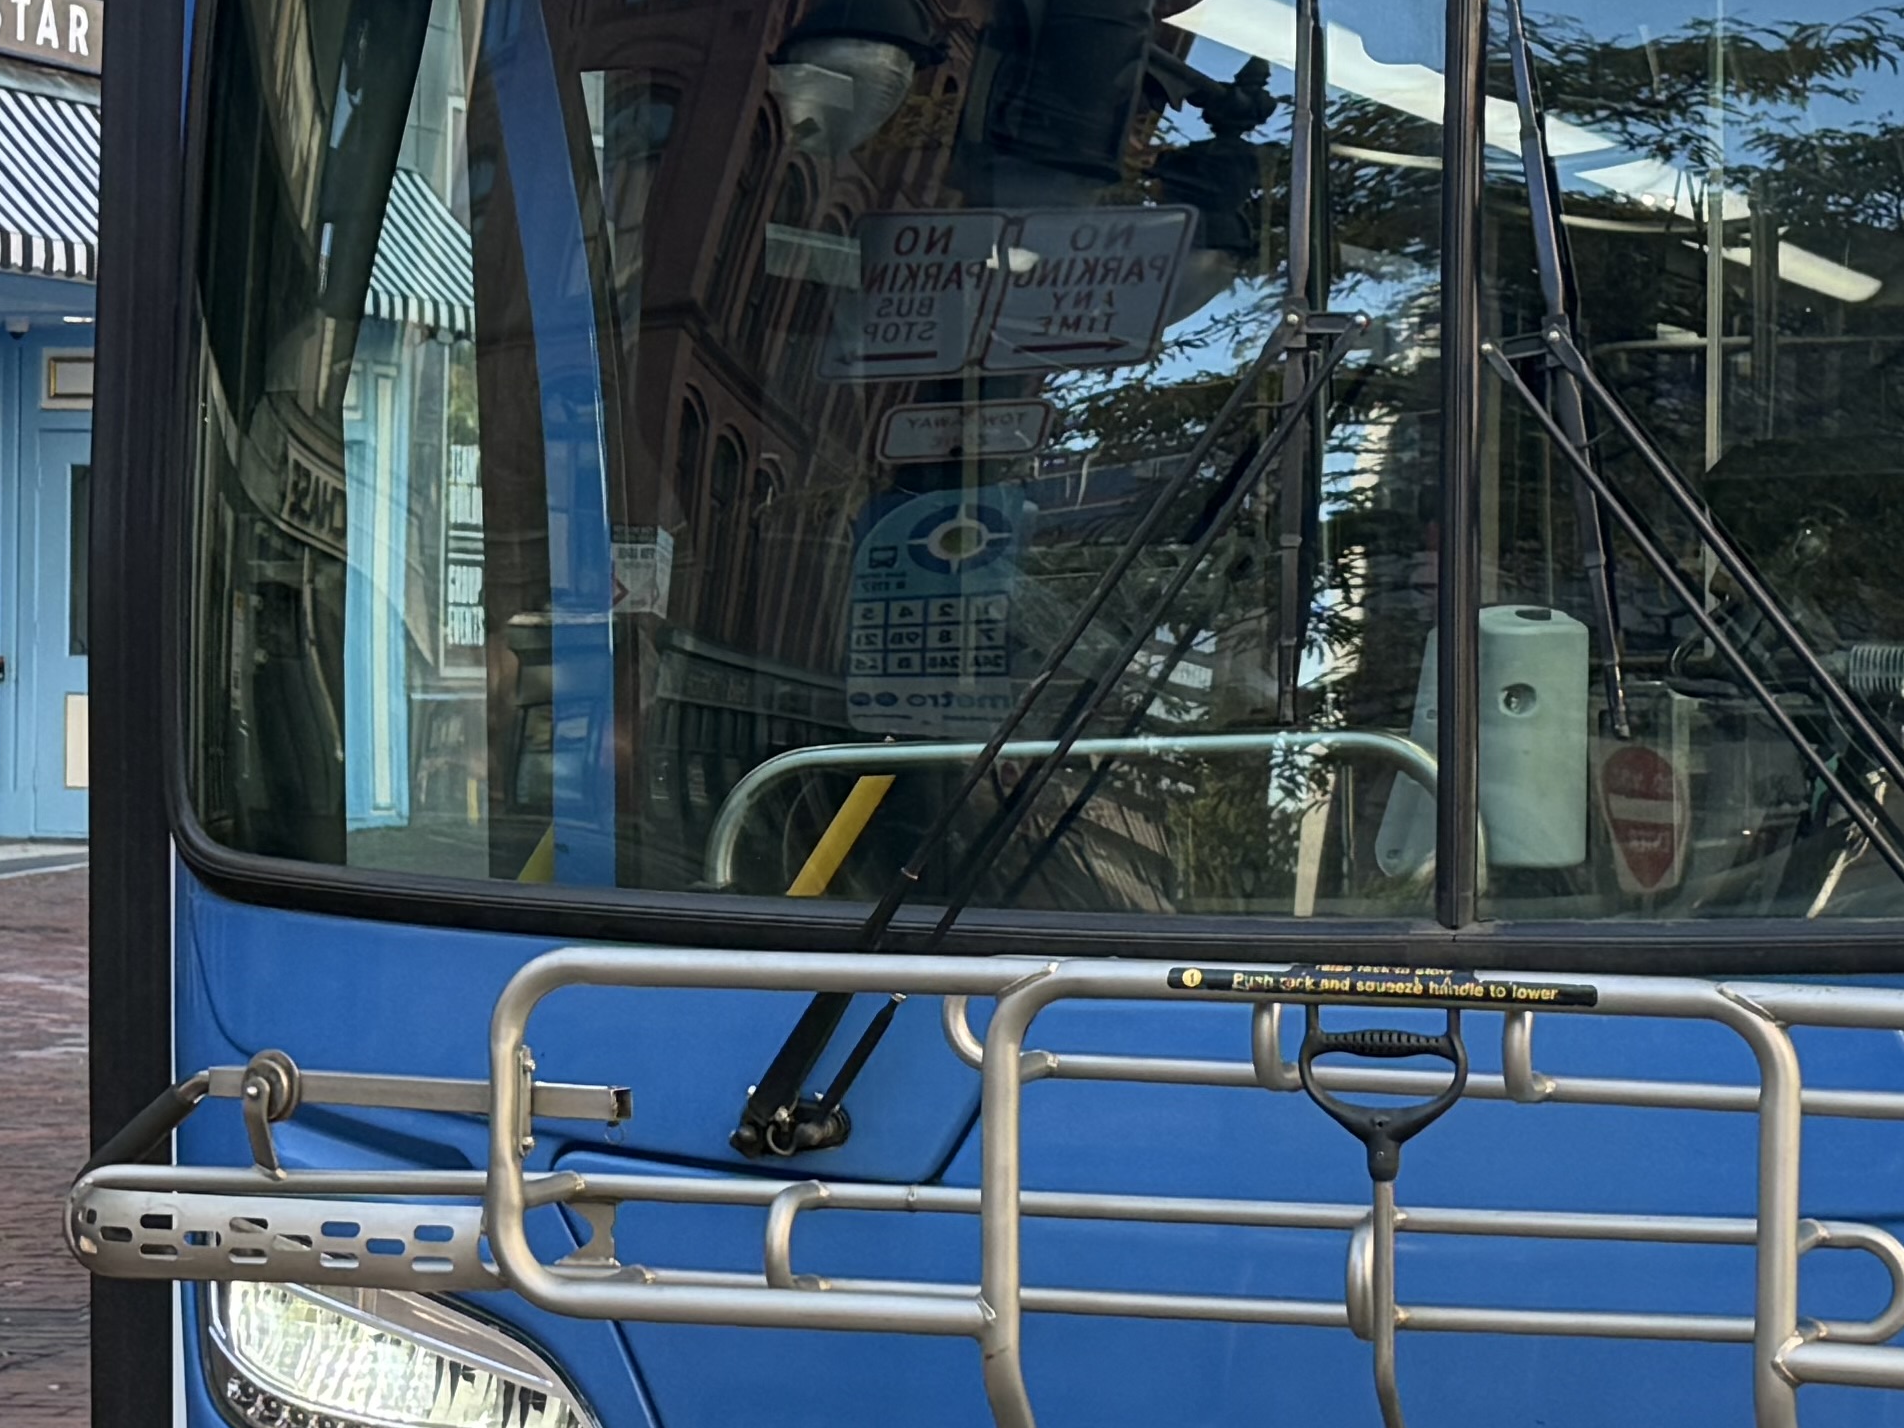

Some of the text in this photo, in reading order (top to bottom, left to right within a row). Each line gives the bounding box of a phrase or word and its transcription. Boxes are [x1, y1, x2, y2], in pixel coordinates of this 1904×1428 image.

[1319, 976, 1350, 992] and
[1489, 984, 1506, 998] to
[1512, 984, 1559, 1000] lower
